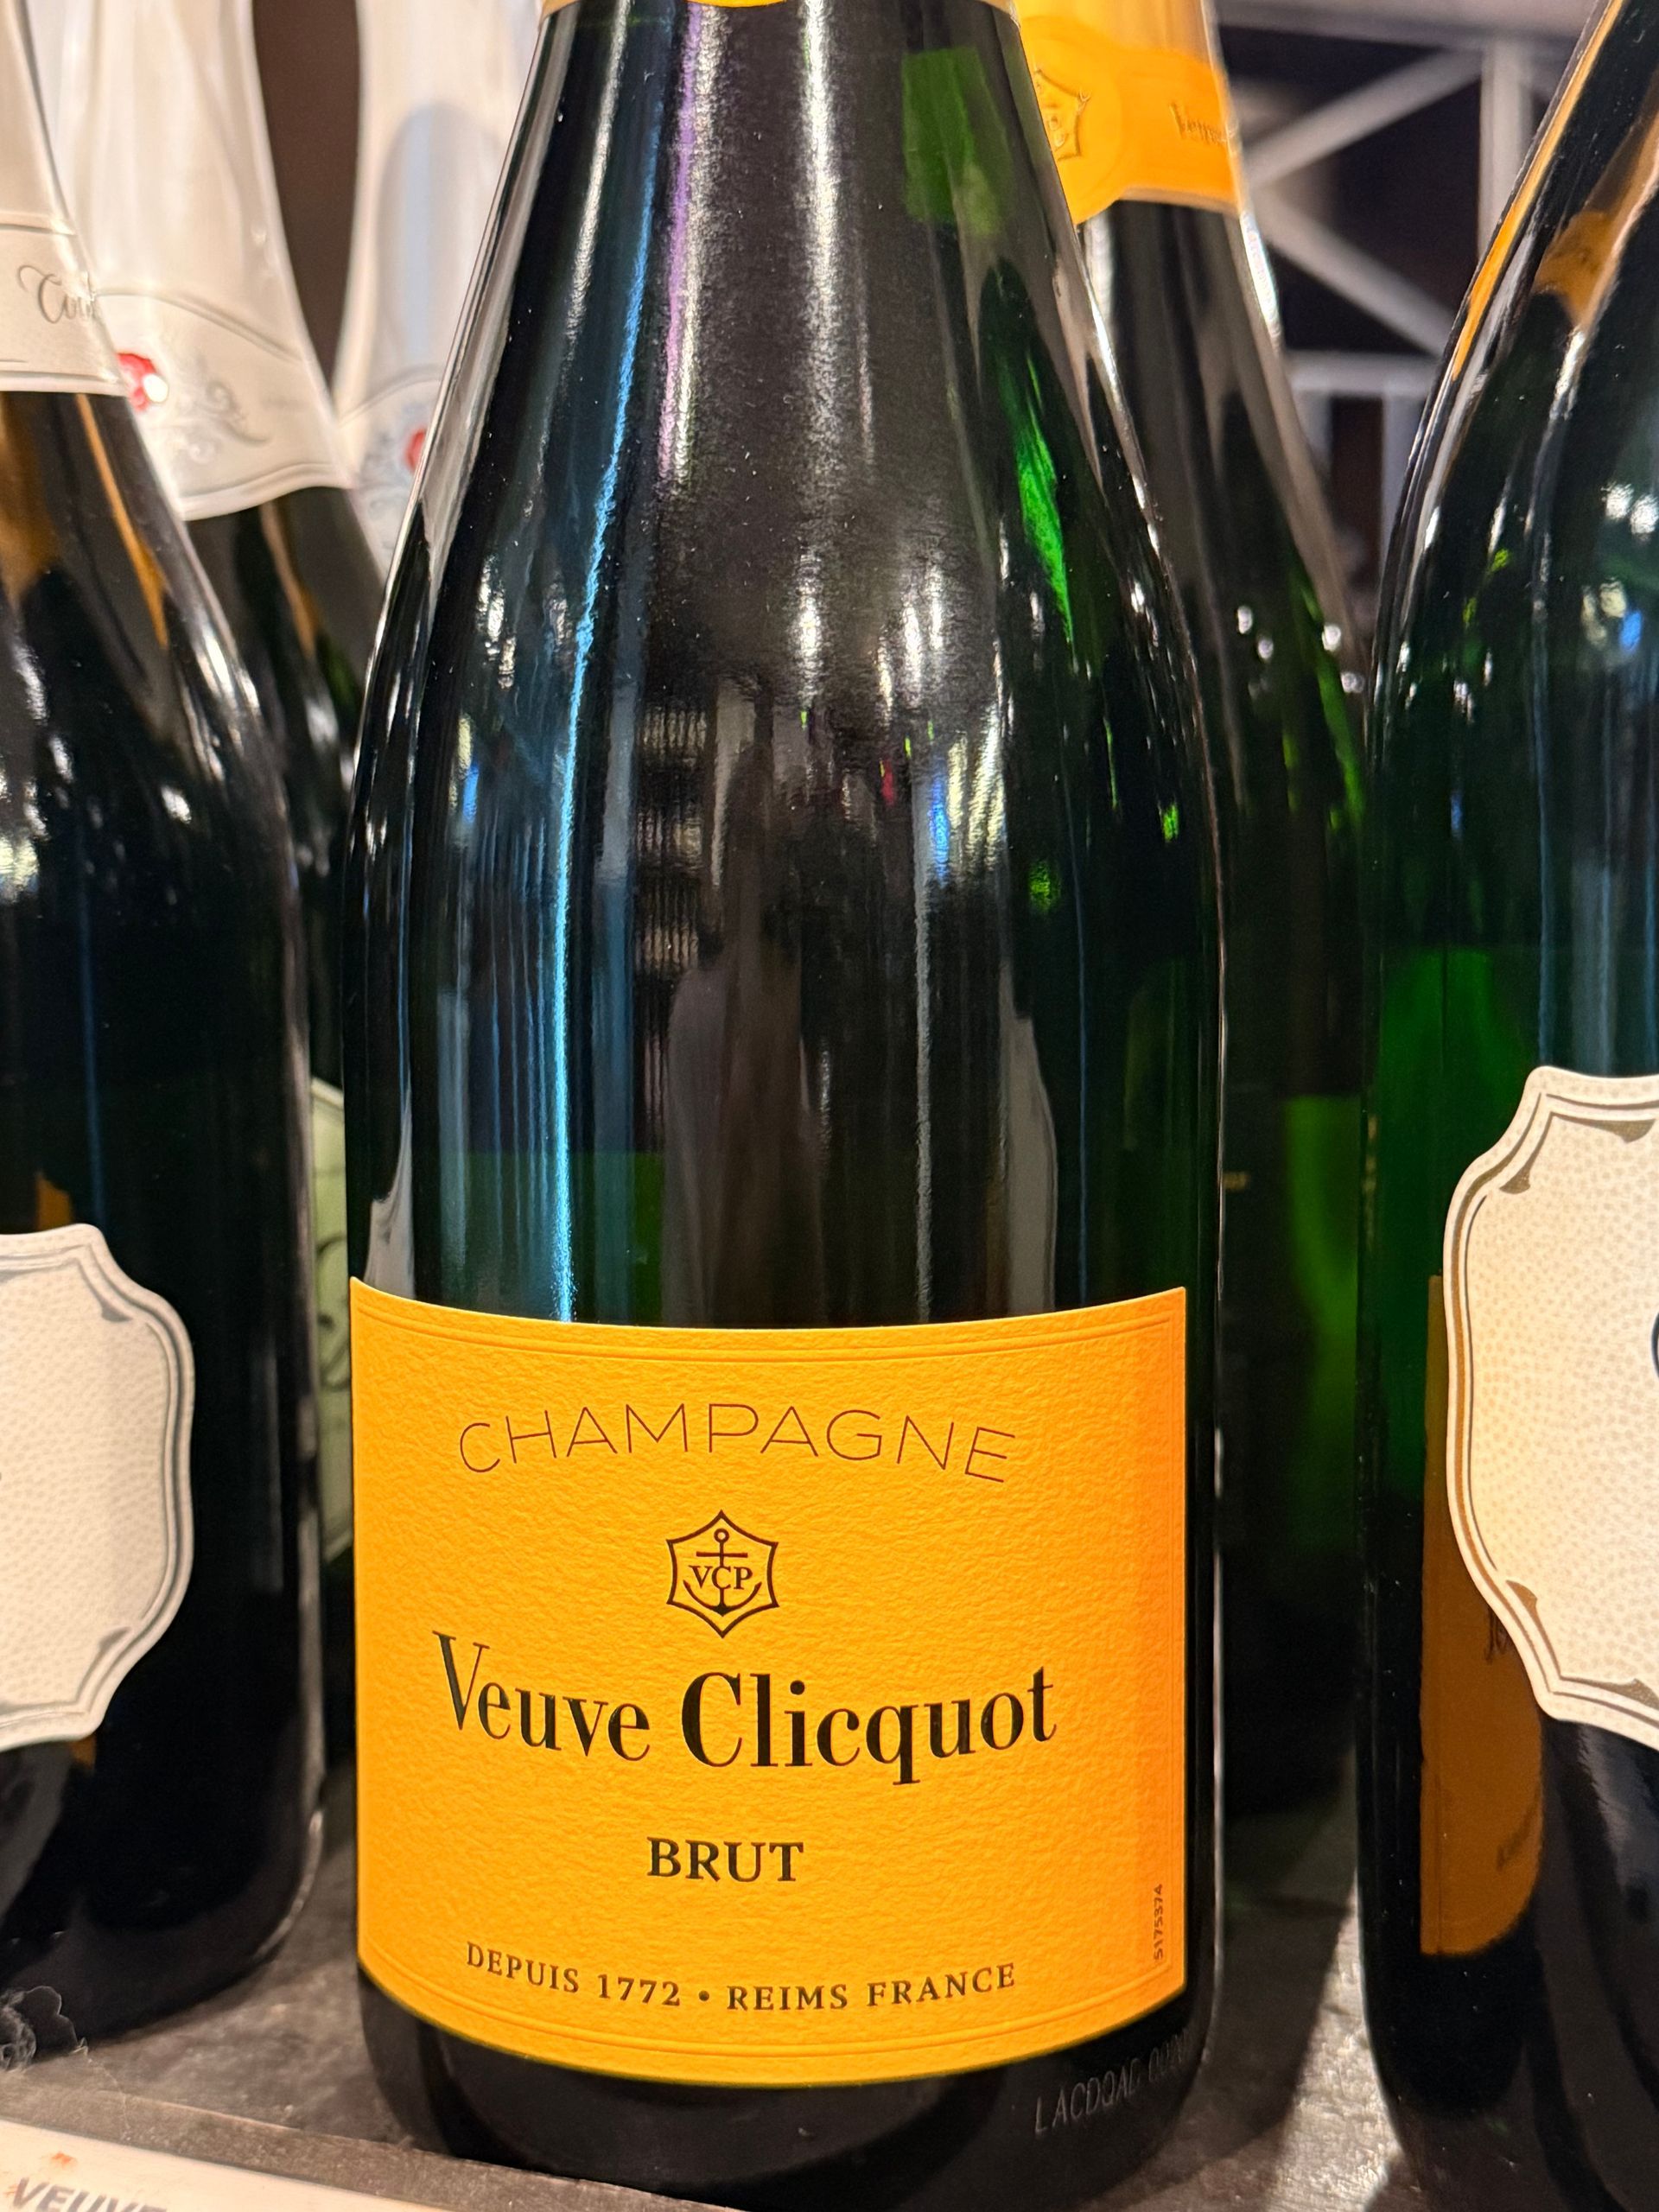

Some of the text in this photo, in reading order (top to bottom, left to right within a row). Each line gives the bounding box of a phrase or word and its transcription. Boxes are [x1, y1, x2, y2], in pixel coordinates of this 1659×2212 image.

[458, 1402, 1016, 1483] CHAMPAGNE
[688, 1564, 753, 1590] VCP
[433, 1630, 1058, 1786] Veuve Clicquot
[646, 1837, 804, 1883] BRUT
[467, 1941, 1016, 2011] DEPUIS 1772 REIMS FRANCE
